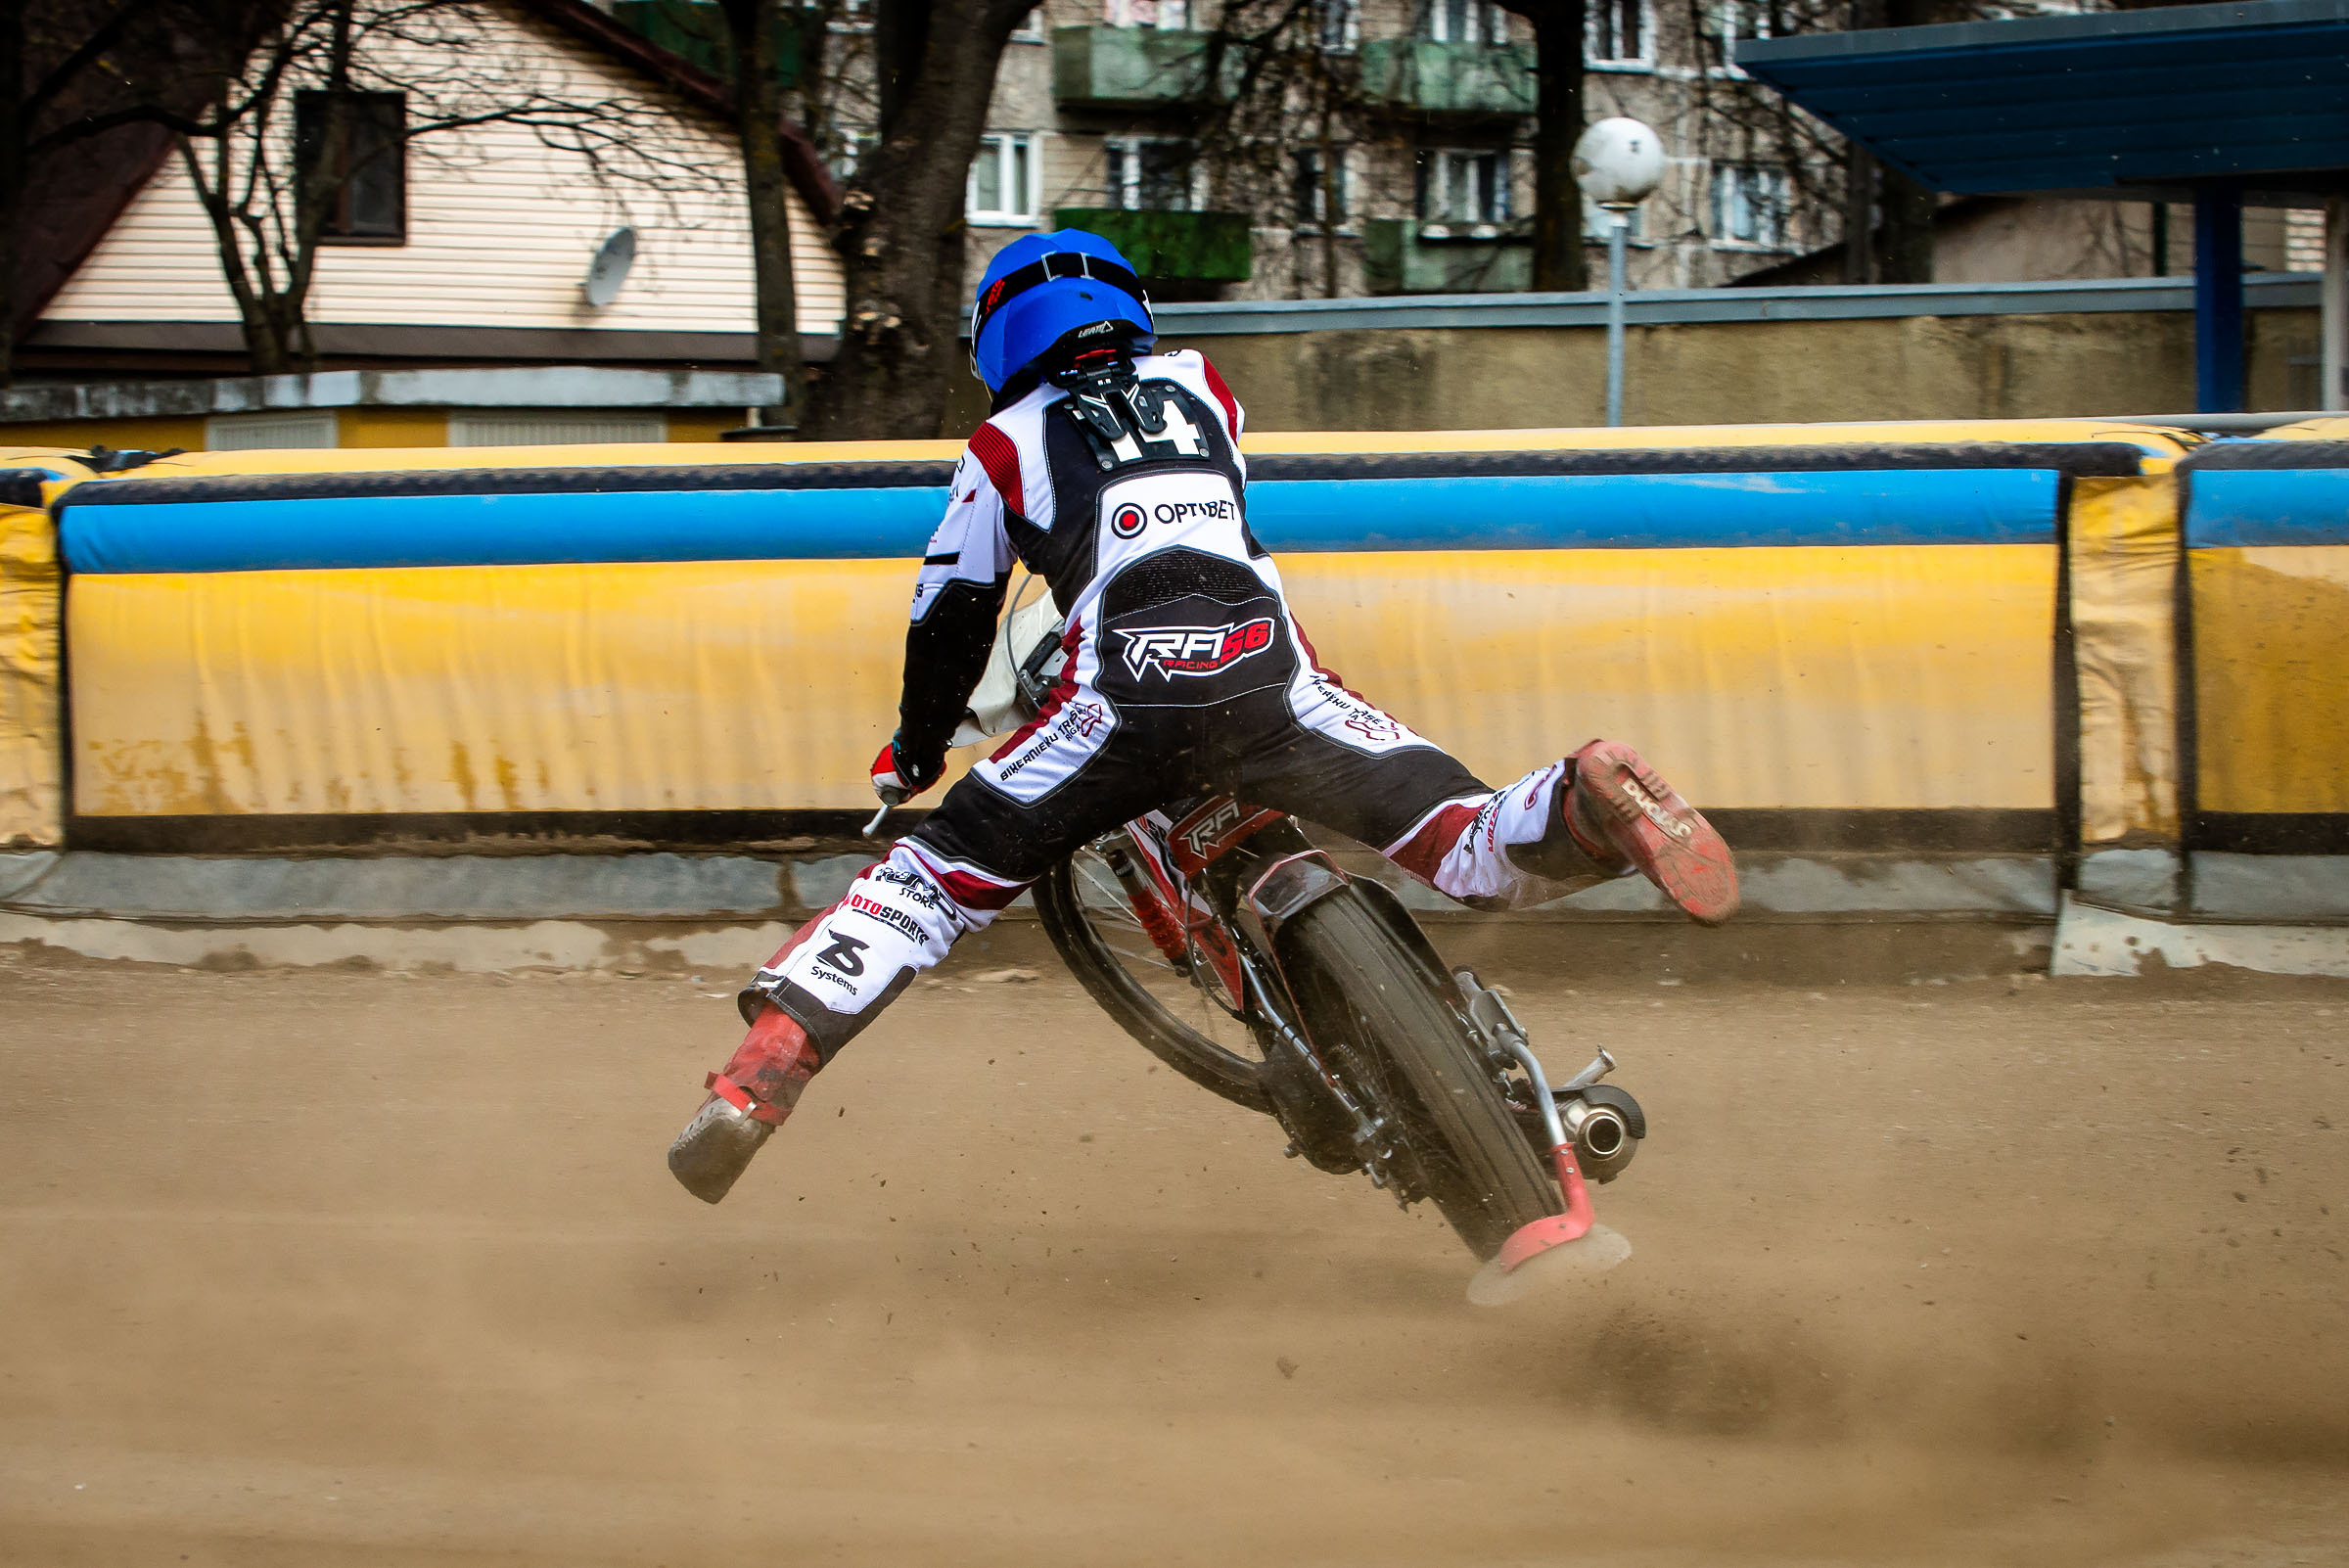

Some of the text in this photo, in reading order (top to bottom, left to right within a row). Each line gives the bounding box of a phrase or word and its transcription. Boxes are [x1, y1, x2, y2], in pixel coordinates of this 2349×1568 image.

[1154, 500, 1235, 524] OPTIBET
[1163, 659, 1219, 669] RACING
[898, 887, 935, 910] STORE
[810, 965, 858, 996] Systems
